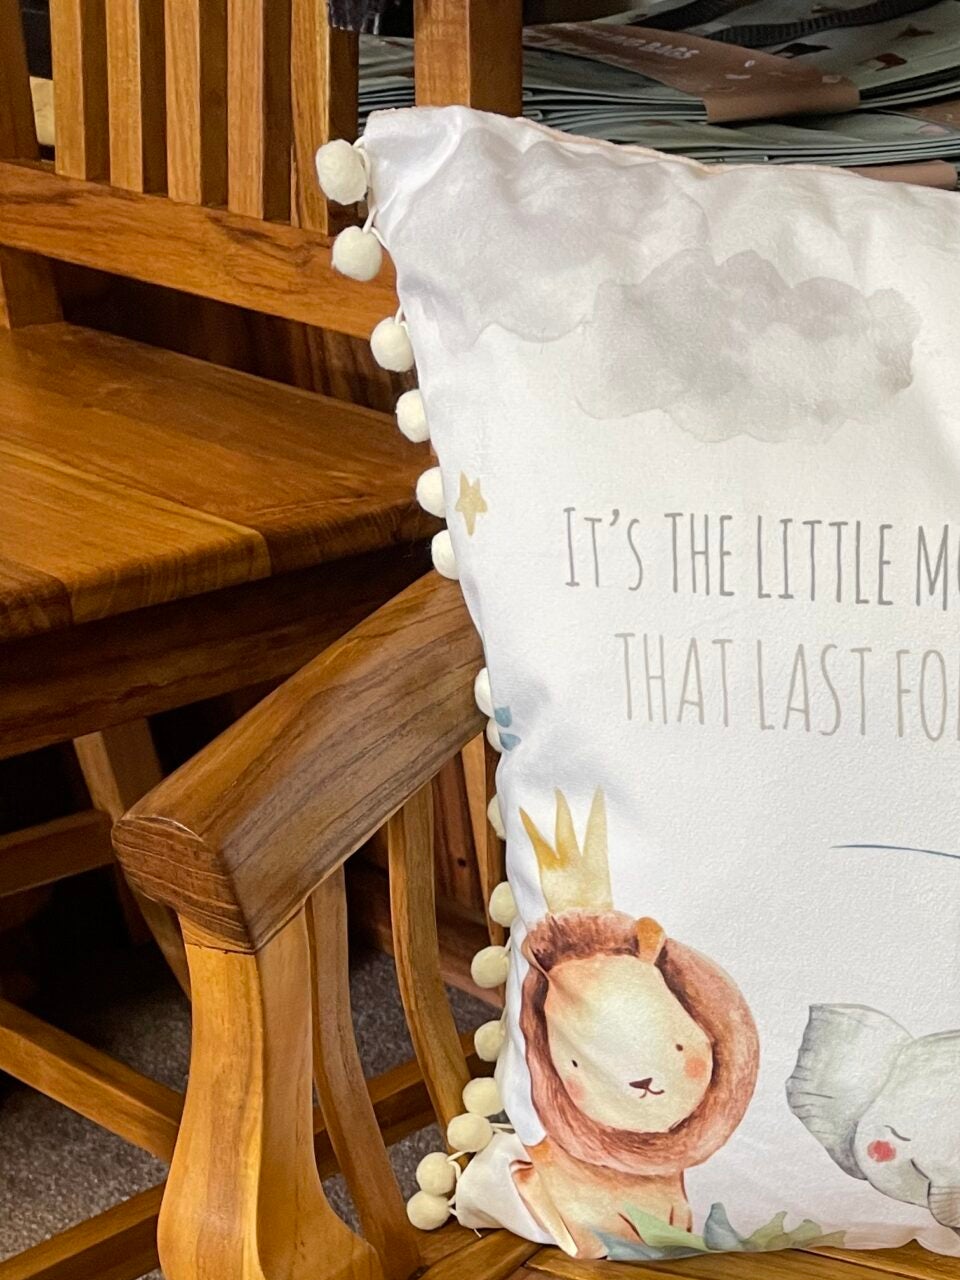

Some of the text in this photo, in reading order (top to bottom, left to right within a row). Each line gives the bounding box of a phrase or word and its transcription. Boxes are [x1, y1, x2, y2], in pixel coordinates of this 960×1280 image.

[562, 506, 644, 592] IT'S
[664, 512, 735, 597] THE
[755, 514, 894, 606] LITTLE
[613, 632, 734, 728] THAT
[756, 639, 873, 737] LAST
